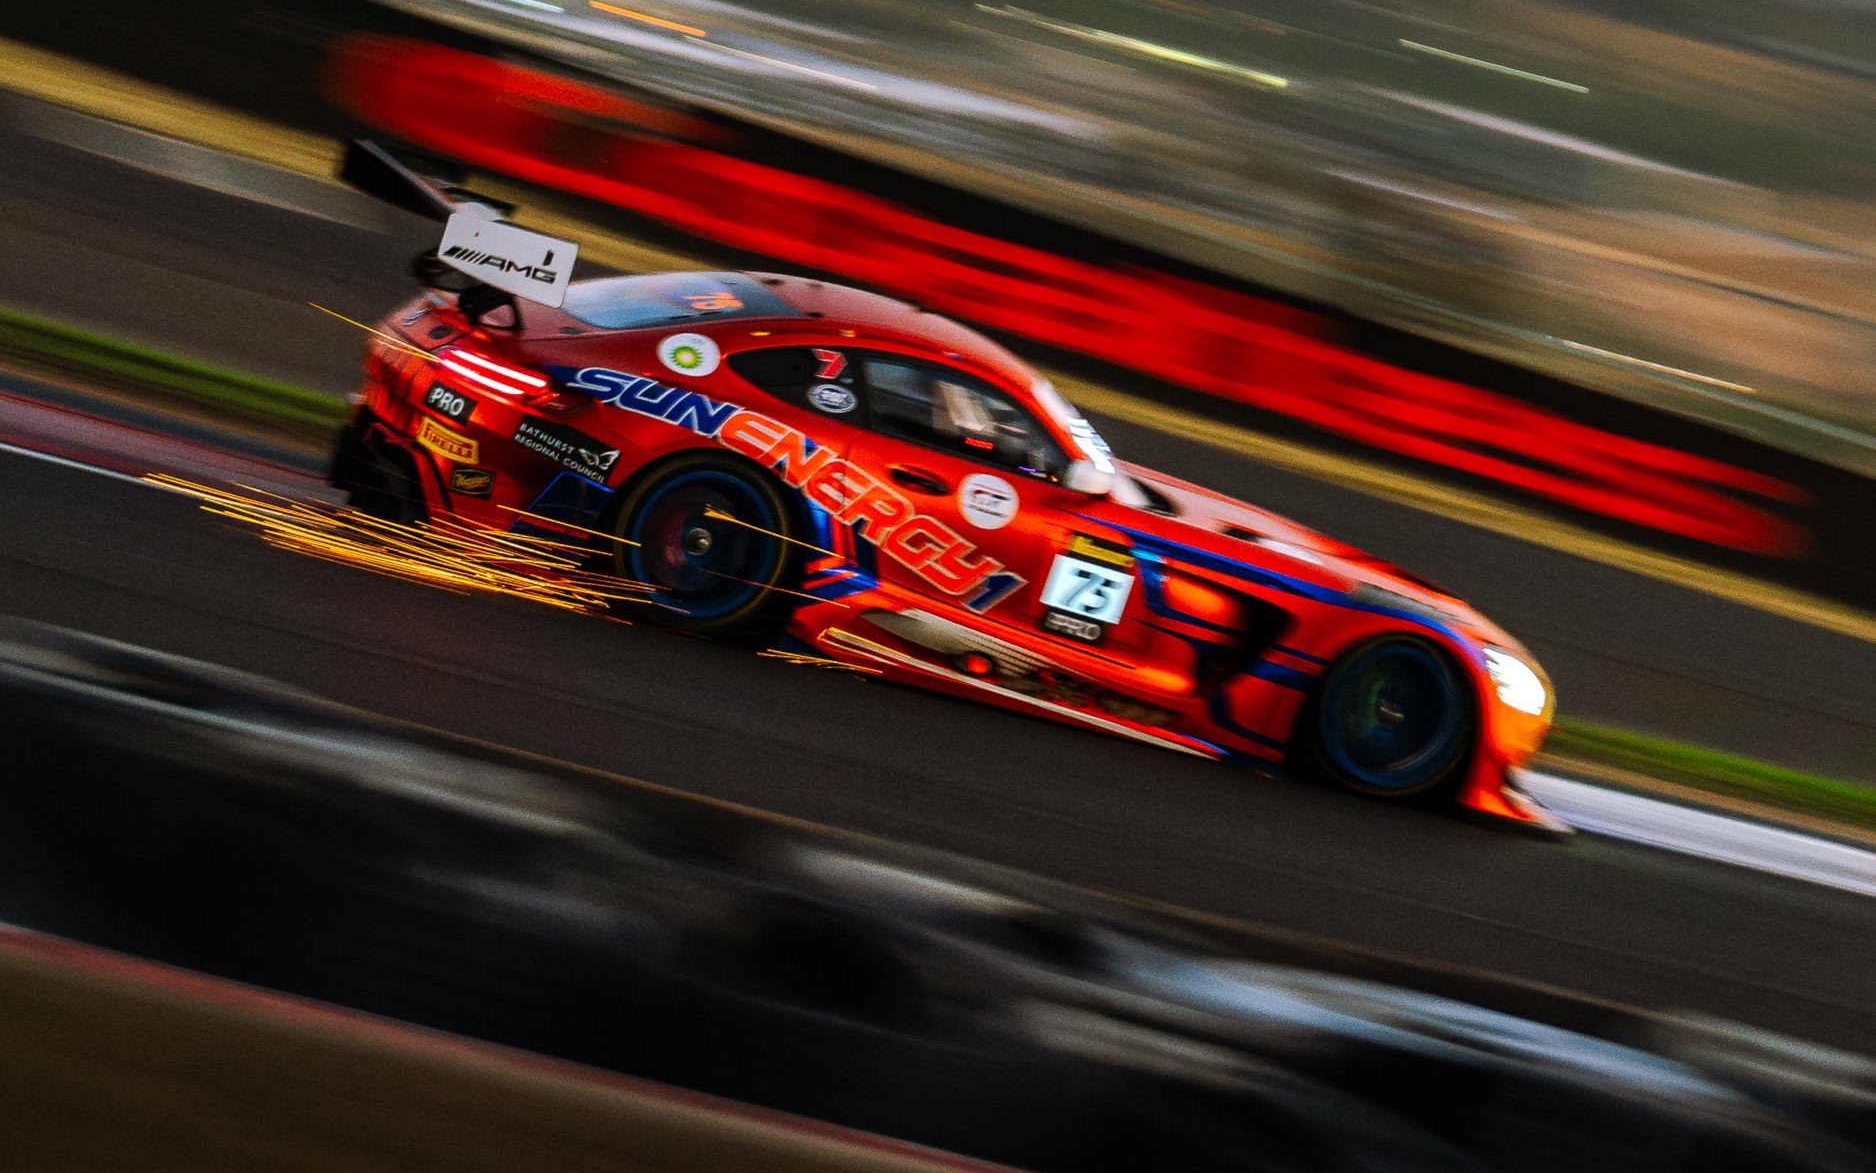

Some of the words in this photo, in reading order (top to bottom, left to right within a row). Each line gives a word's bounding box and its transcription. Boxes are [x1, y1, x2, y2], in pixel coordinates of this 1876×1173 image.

[478, 254, 558, 285] AMG
[427, 386, 465, 417] PRO
[519, 422, 576, 455] BATHURST
[513, 433, 561, 462] REGIONAL
[562, 457, 607, 484] COUNCIL
[1065, 567, 1122, 615] 75
